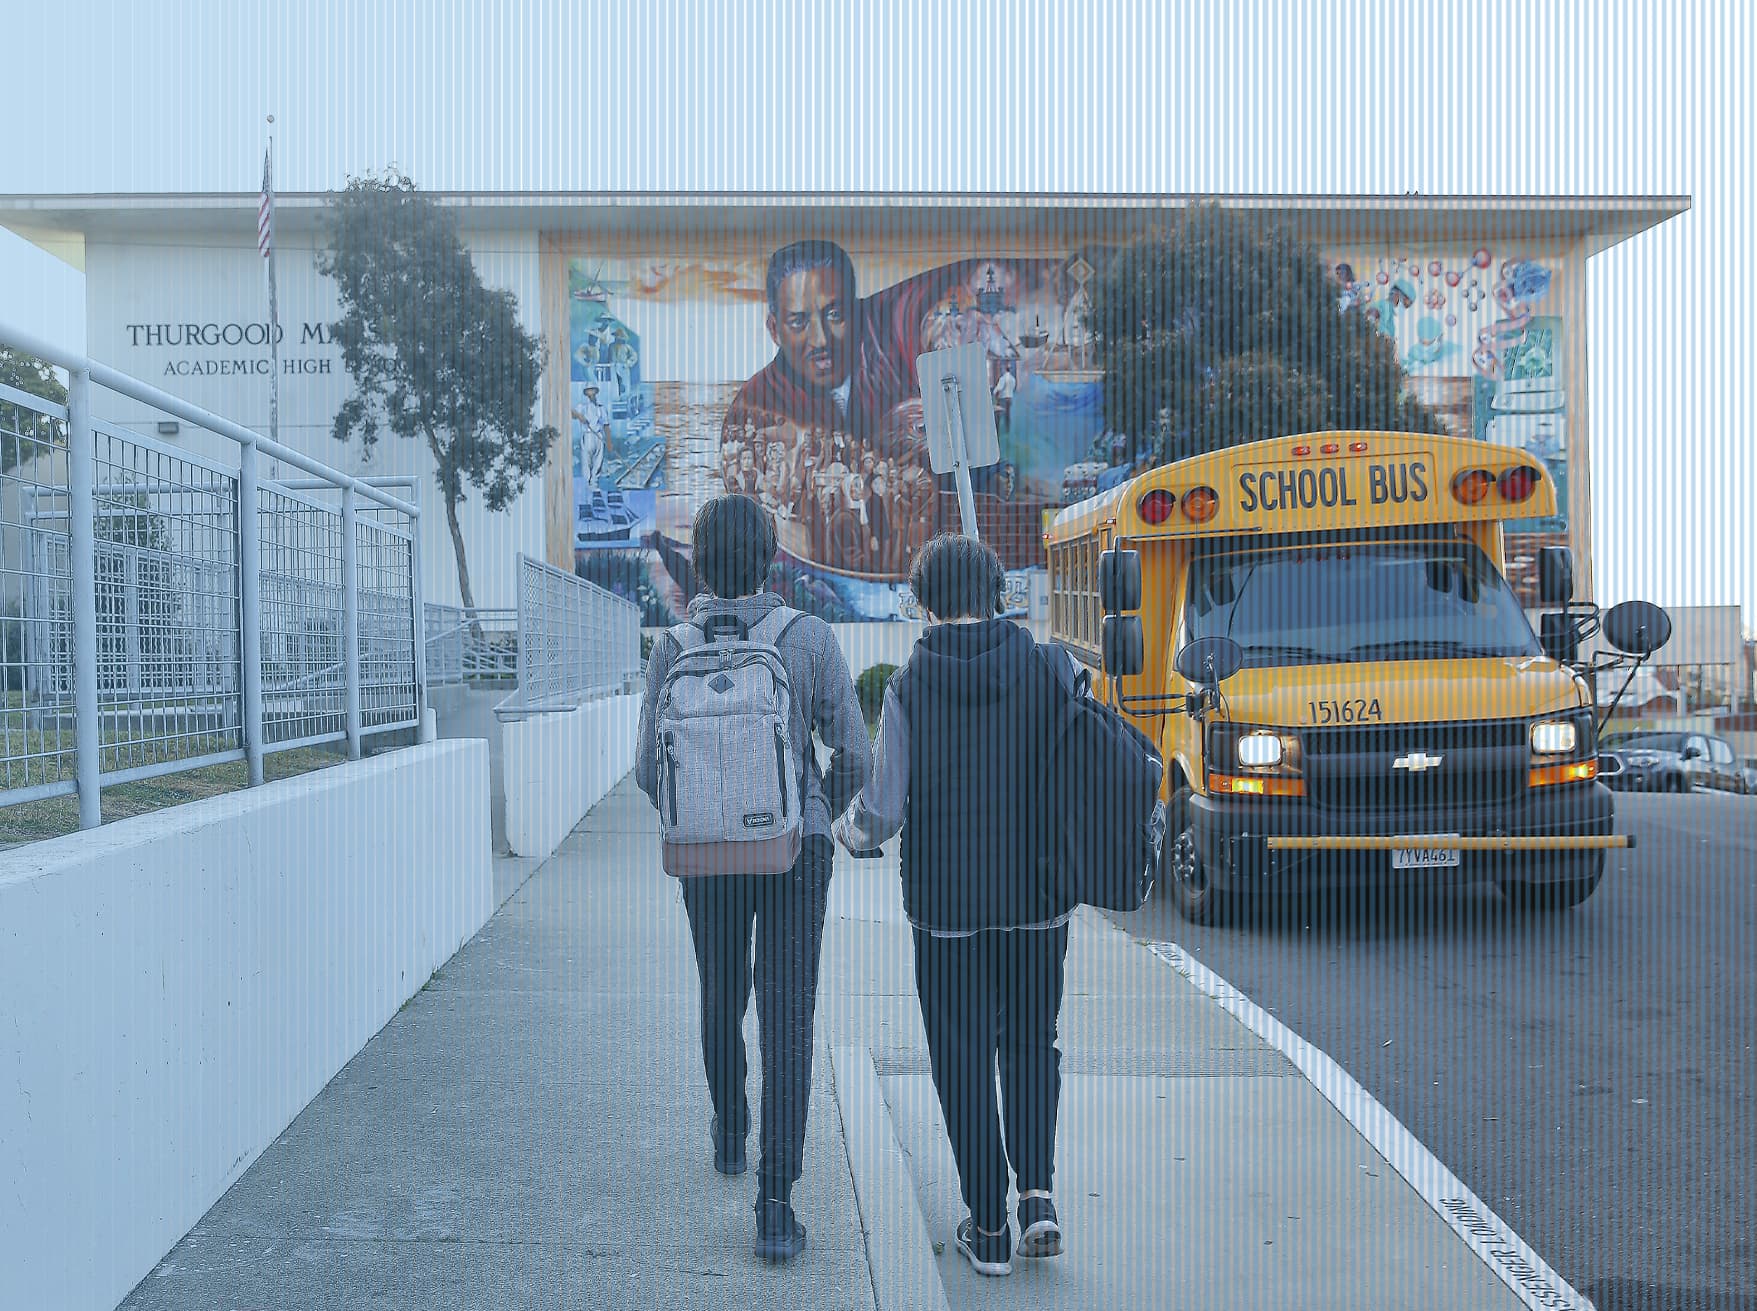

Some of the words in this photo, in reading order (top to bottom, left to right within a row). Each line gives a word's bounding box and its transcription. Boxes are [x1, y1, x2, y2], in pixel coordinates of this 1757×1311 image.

[126, 323, 283, 347] THURGOOD
[164, 359, 270, 376] ACADEMIC
[283, 358, 331, 375] HIGH
[1239, 466, 1357, 512] SCHOOL
[1368, 462, 1428, 505] BUS
[1308, 698, 1383, 724] 151624
[1439, 1198, 1507, 1244] LOADING
[1490, 1249, 1577, 1311] SSENGER
